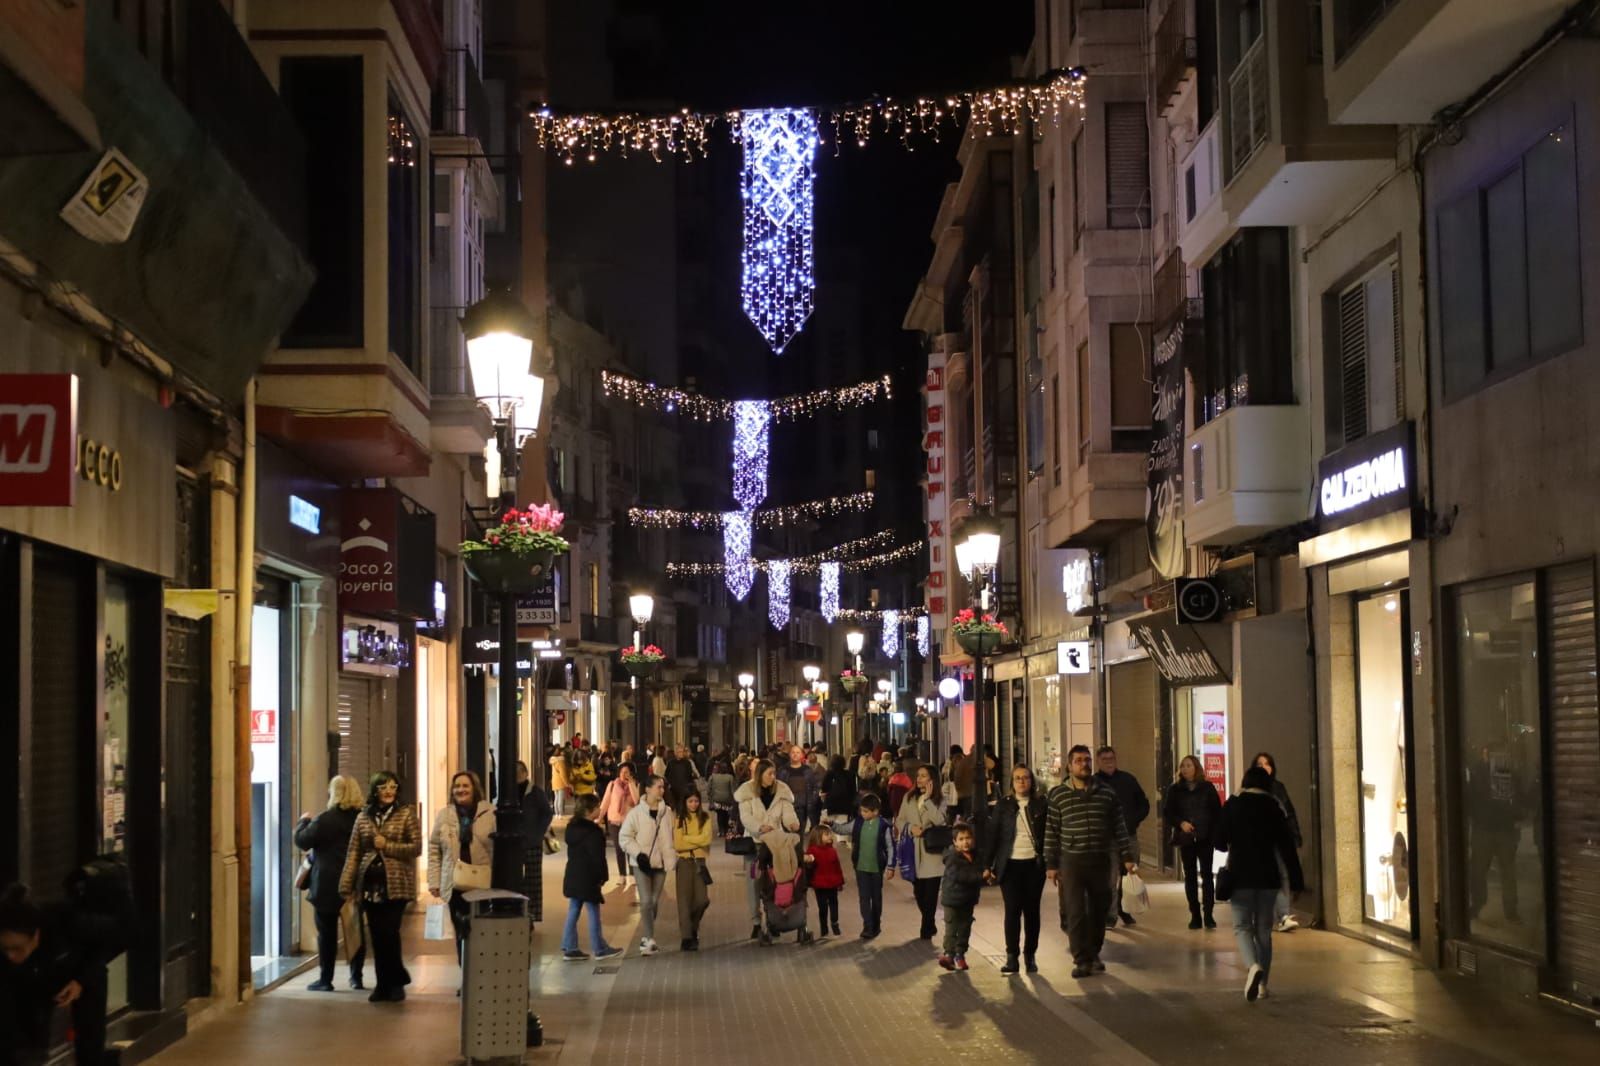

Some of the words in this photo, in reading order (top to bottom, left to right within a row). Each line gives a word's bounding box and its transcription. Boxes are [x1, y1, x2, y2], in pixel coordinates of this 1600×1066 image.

[1321, 447, 1405, 515] CALZEDONIA
[337, 561, 379, 575] Paco
[383, 561, 393, 575] 2
[517, 611, 523, 620] 5
[526, 611, 538, 620] 33
[540, 610, 552, 619] 33
